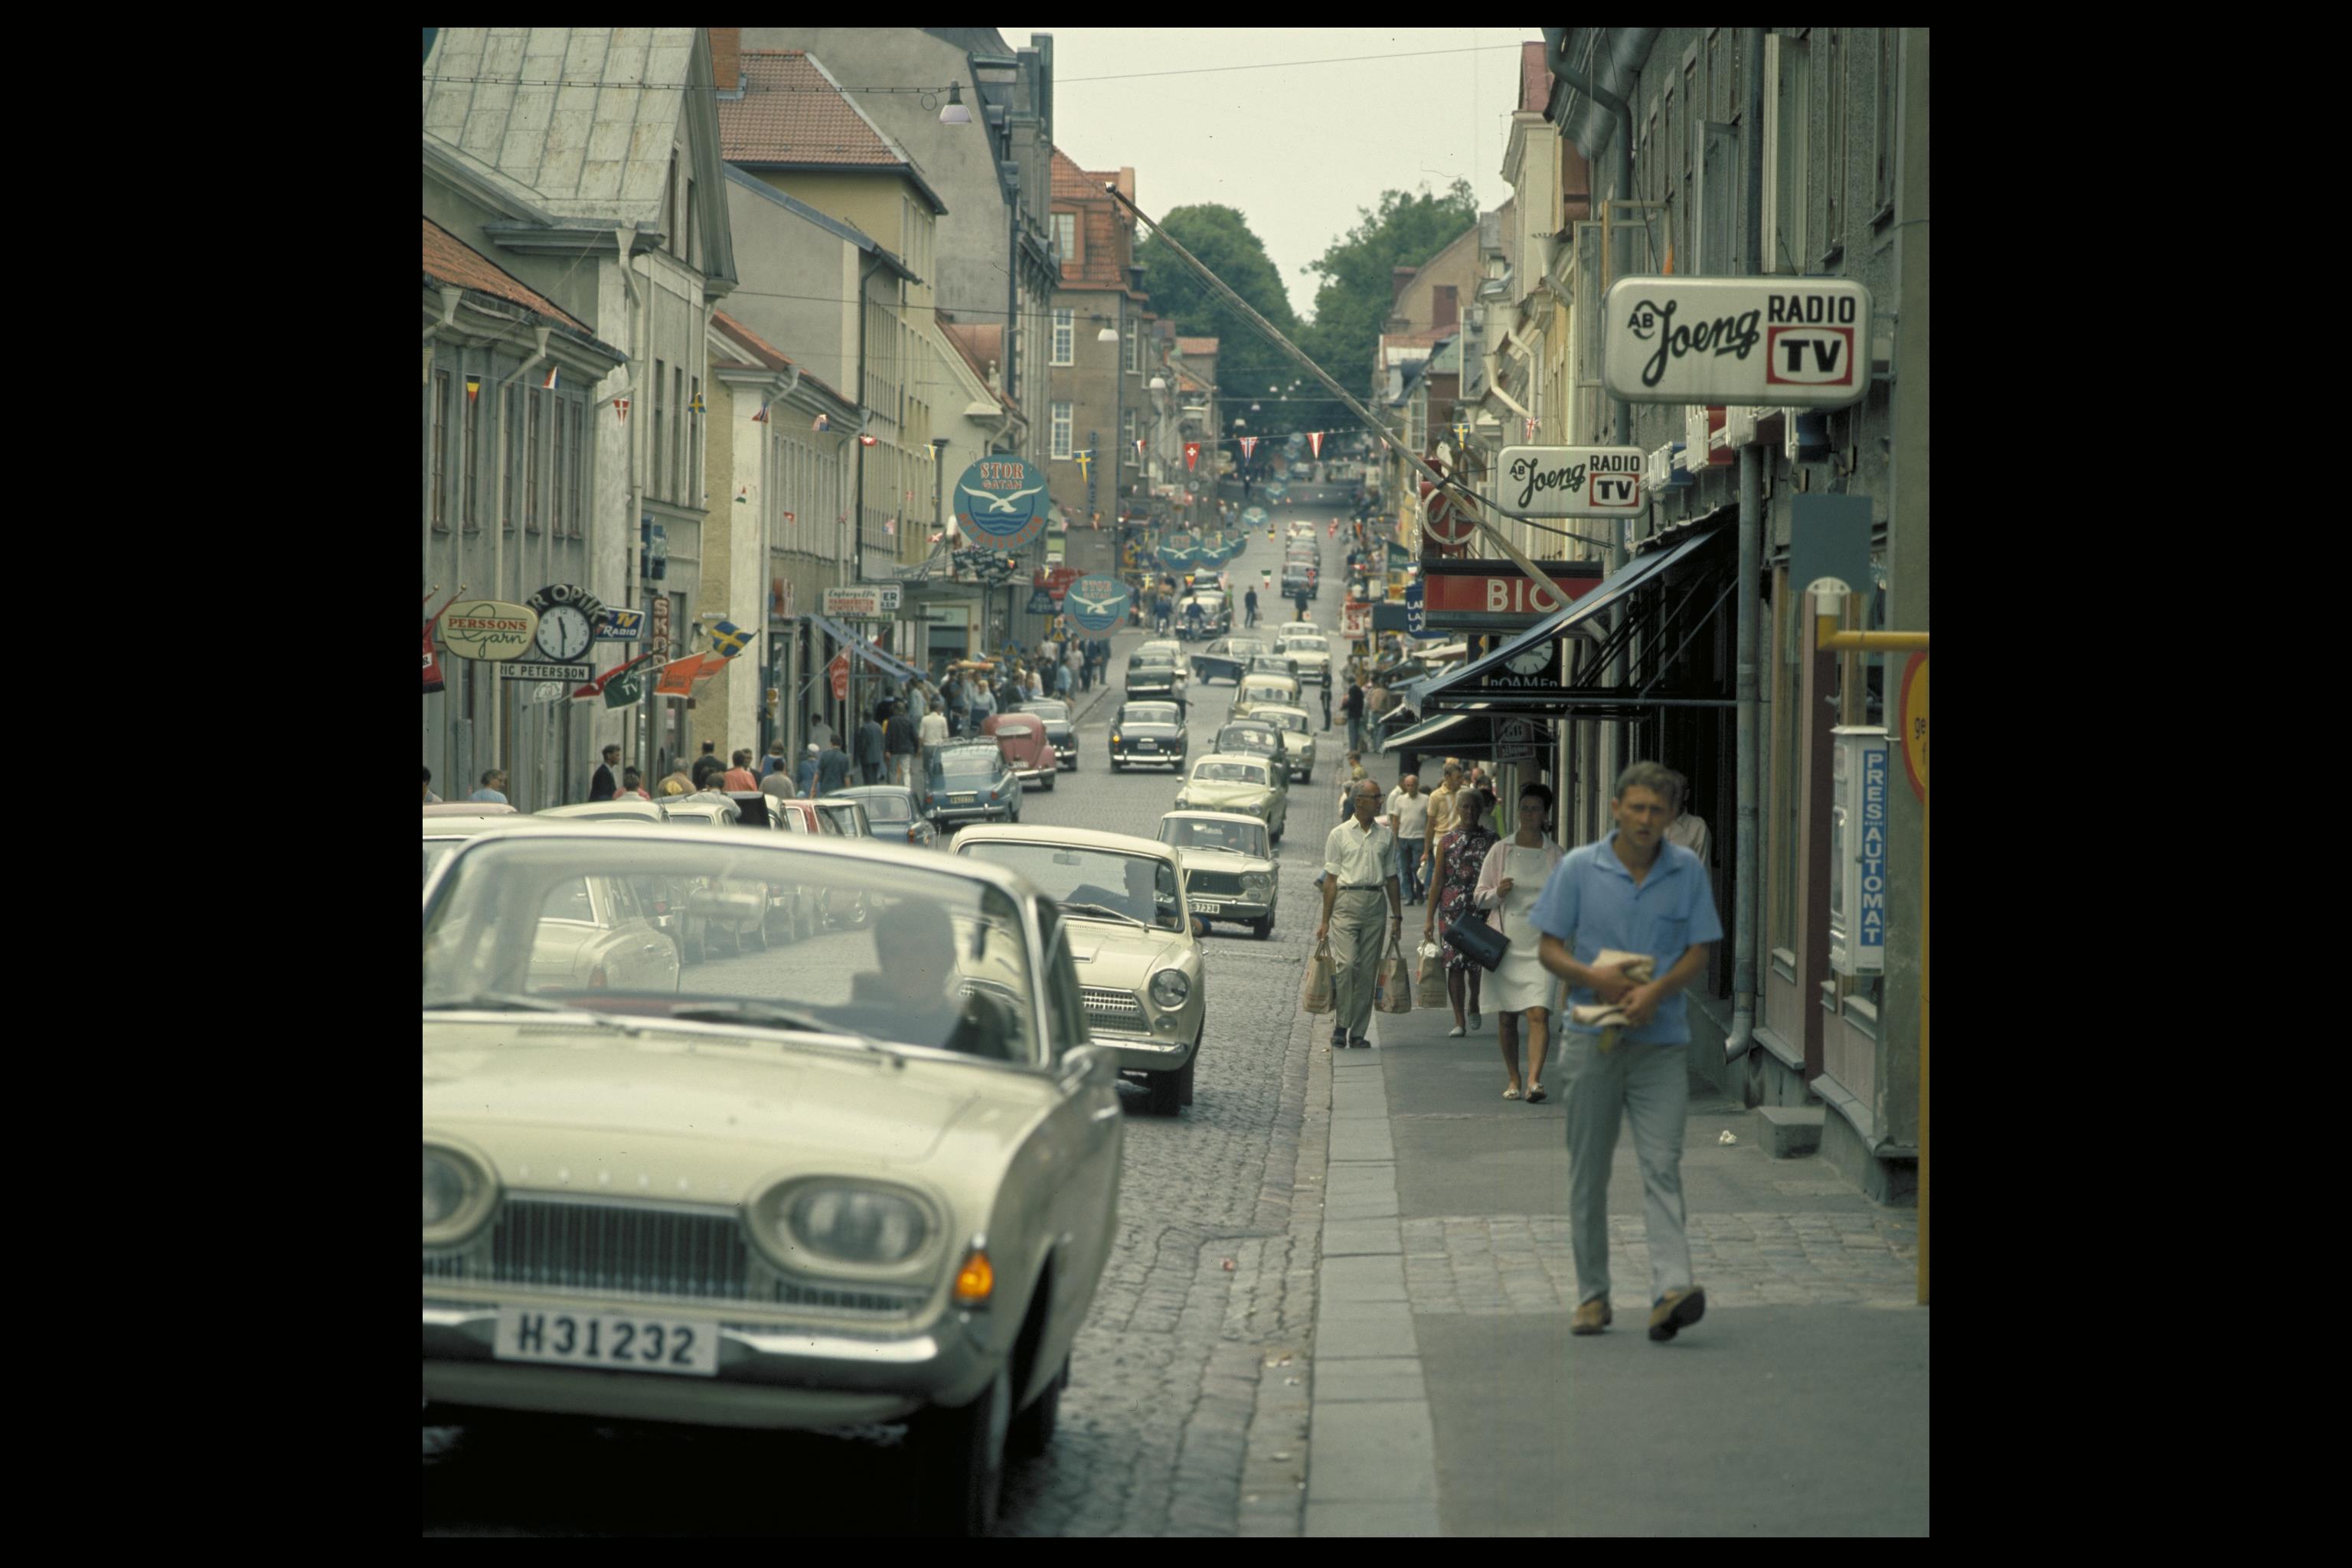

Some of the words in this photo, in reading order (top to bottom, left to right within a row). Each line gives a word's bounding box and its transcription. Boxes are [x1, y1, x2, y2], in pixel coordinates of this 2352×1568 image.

[1627, 312, 1654, 328] AB
[1768, 295, 1855, 323] RADIO
[1635, 299, 1761, 387] Joeng
[1780, 339, 1841, 373] TV
[980, 462, 1024, 479] STOR
[1509, 466, 1525, 475] AB
[1590, 455, 1640, 472] RADIO
[982, 480, 1023, 490] GATAN
[1514, 458, 1586, 508] Joeng
[1596, 481, 1632, 500] TV
[551, 584, 609, 624] OPTIK
[447, 603, 527, 658] Garn
[448, 618, 527, 630] PERSSONS
[616, 612, 638, 627] TV
[498, 665, 515, 675] RIC
[521, 665, 585, 678] PETERSSON
[1867, 753, 1883, 820] PRES
[1863, 827, 1883, 943] AUTOMAT
[517, 1313, 695, 1366] H31232
